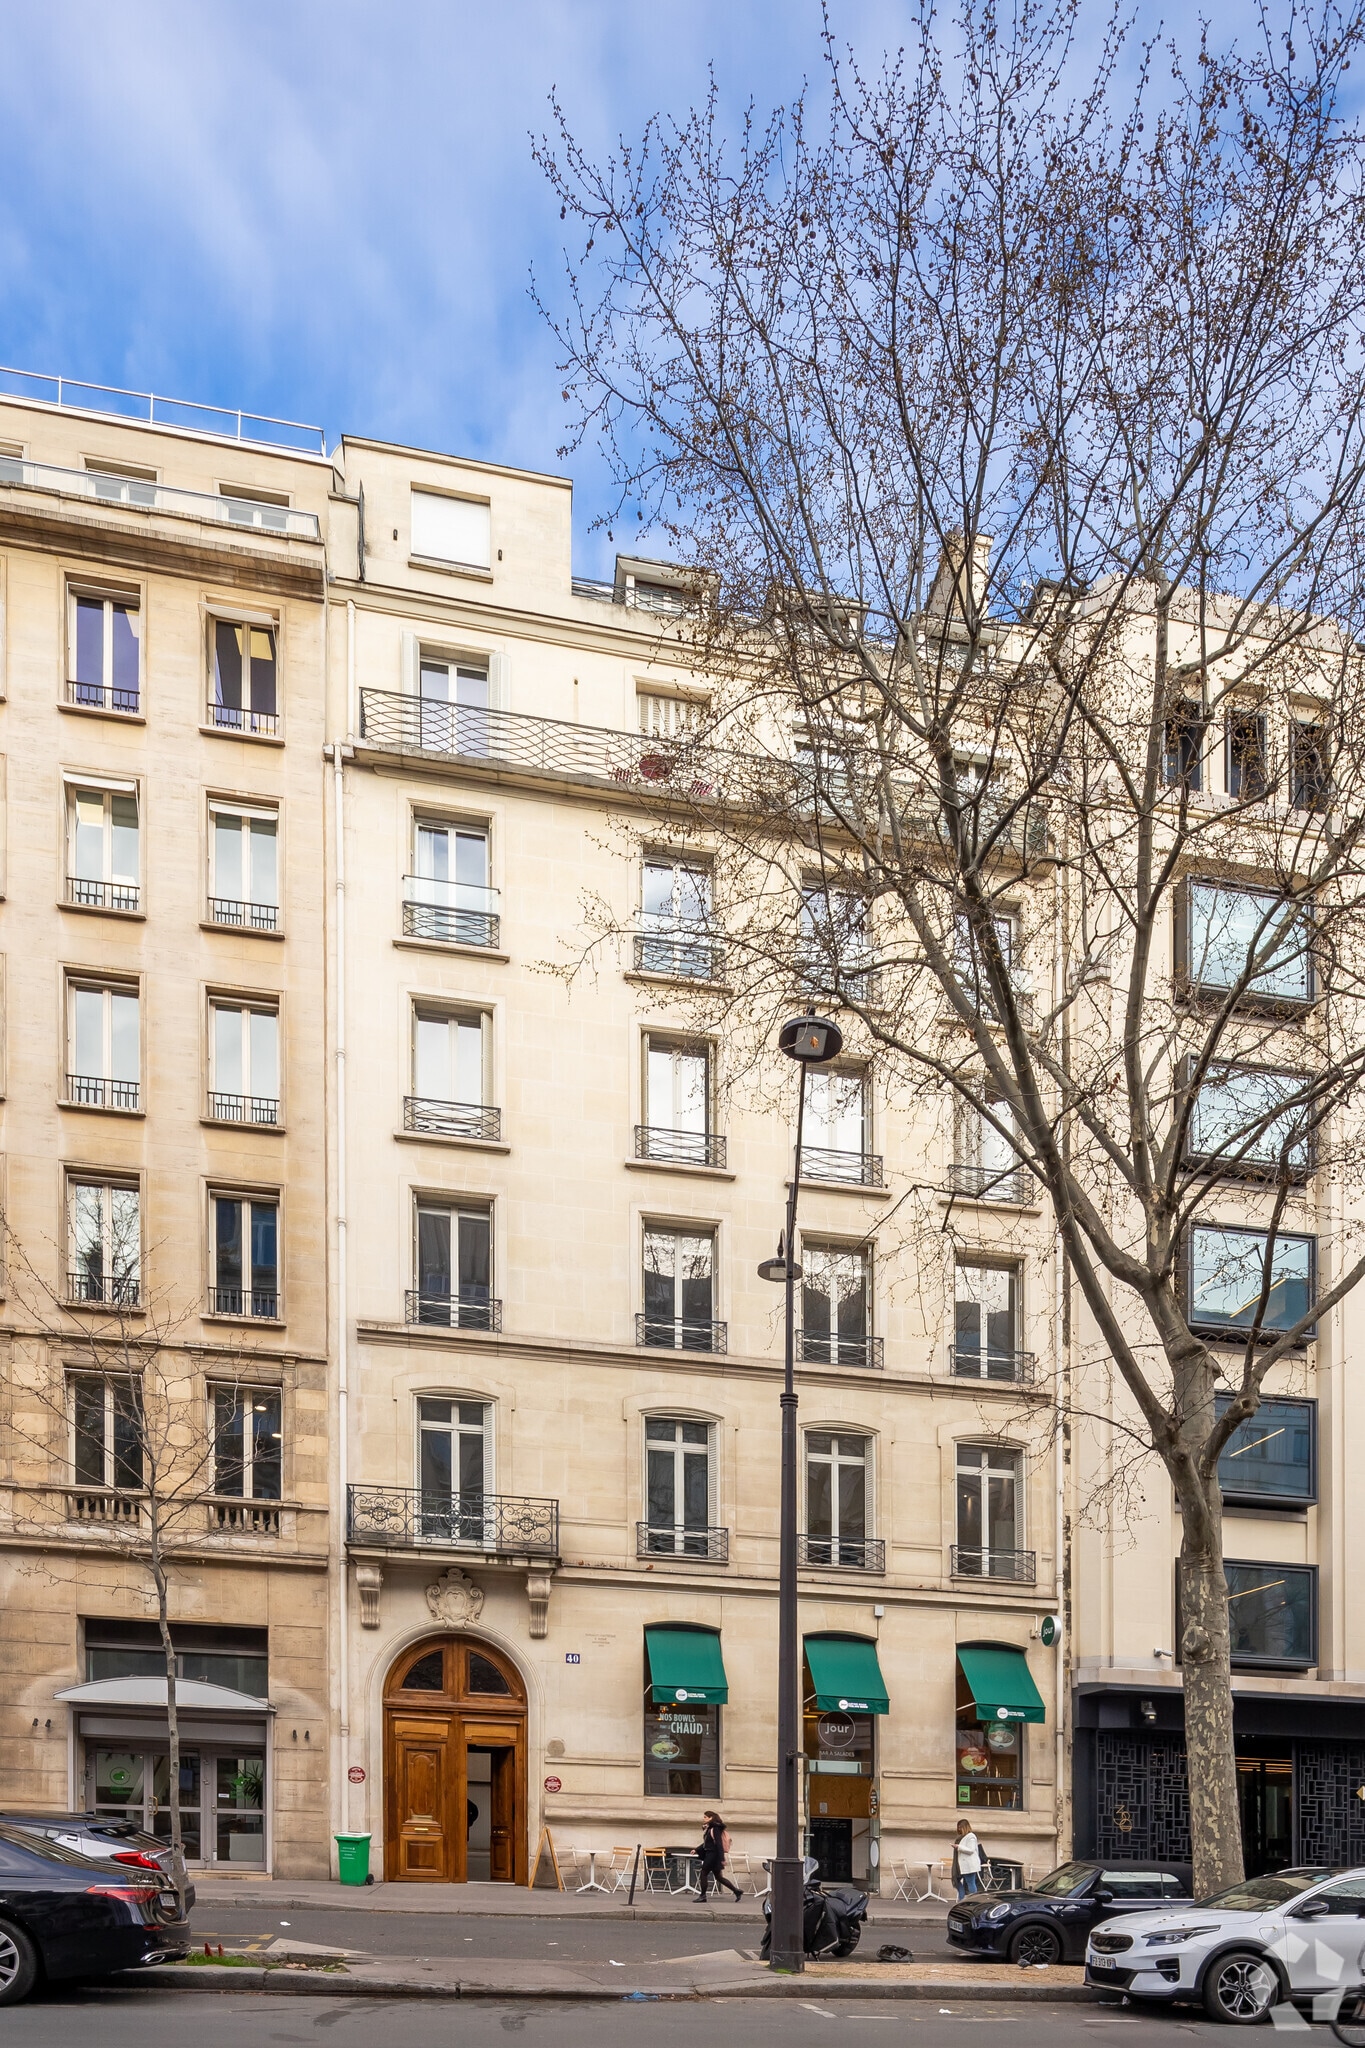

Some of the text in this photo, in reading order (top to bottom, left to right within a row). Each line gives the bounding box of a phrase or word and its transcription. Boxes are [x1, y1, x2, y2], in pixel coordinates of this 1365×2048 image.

[1042, 1626, 1053, 1637] jour
[566, 1654, 579, 1663] 40
[674, 1714, 695, 1722] BOWLS
[671, 1722, 710, 1735] CHAUD !
[825, 1723, 849, 1734] jour
